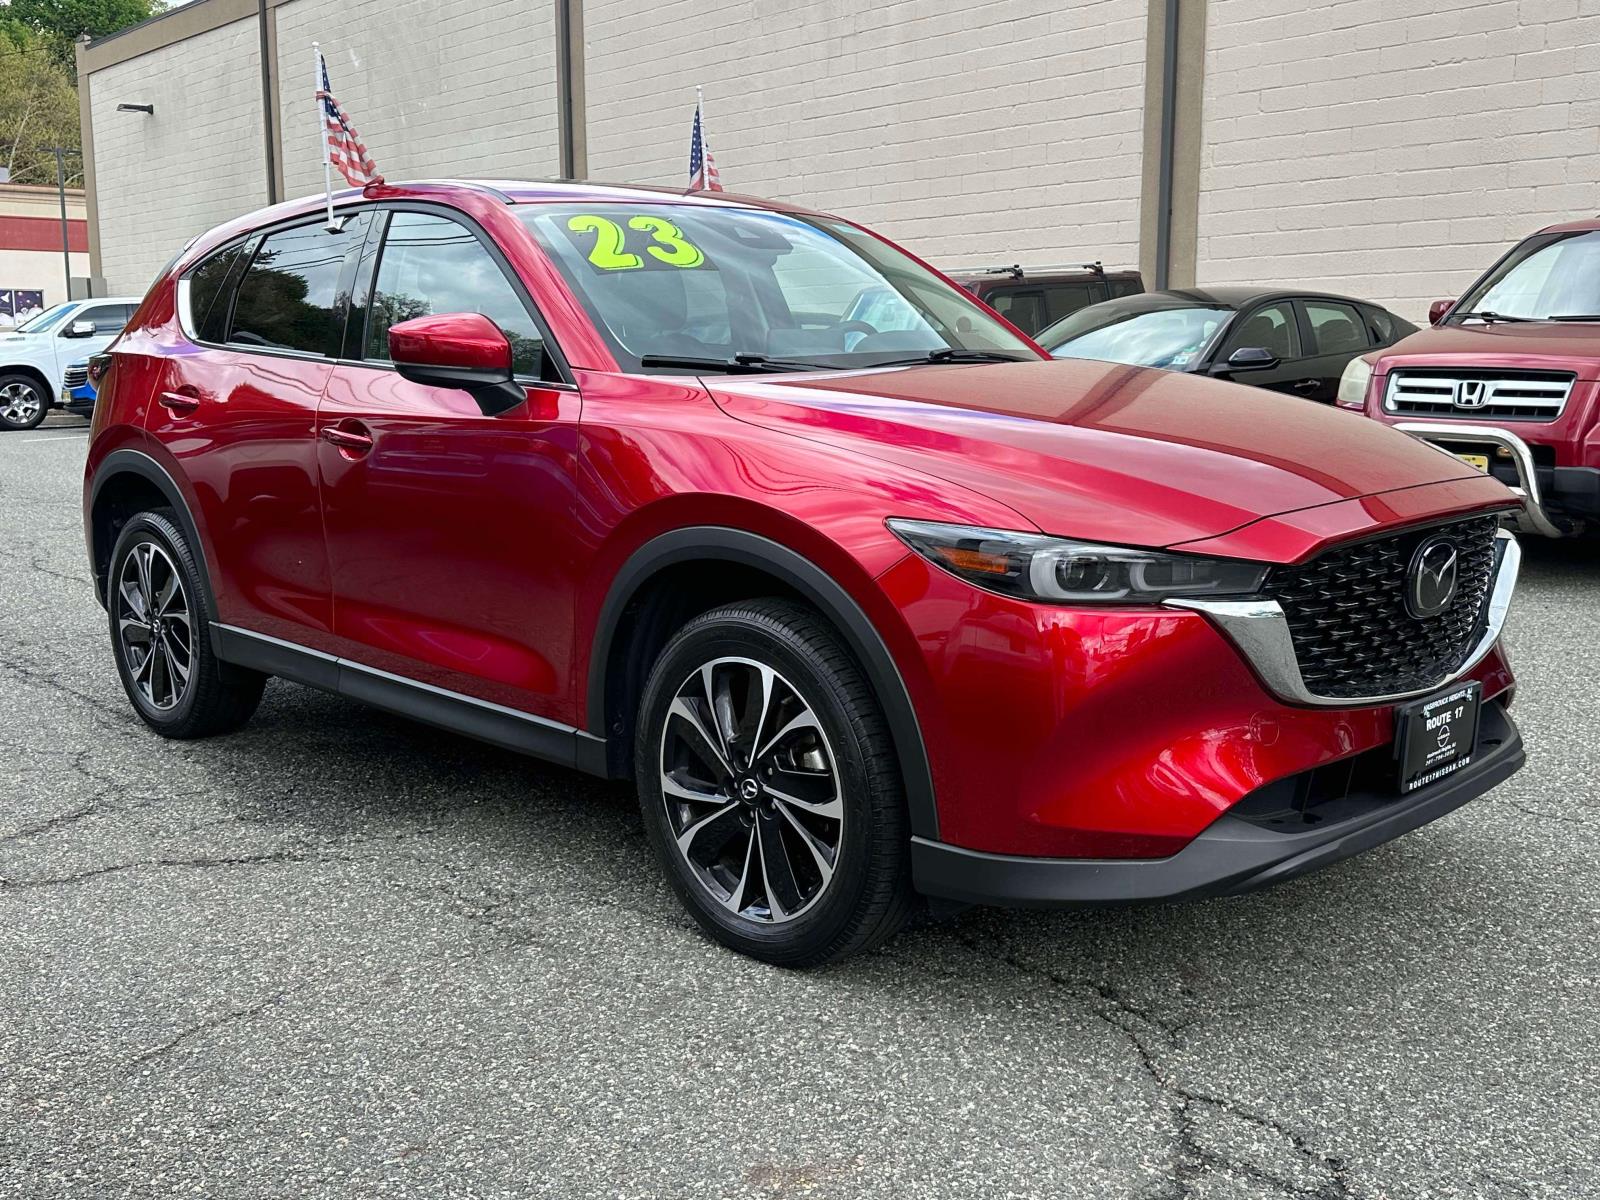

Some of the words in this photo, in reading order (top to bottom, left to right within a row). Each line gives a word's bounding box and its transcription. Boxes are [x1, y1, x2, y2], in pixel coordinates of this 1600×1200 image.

[567, 215, 705, 271] 23
[1426, 710, 1452, 731] ROUTE
[1454, 705, 1464, 719] 17
